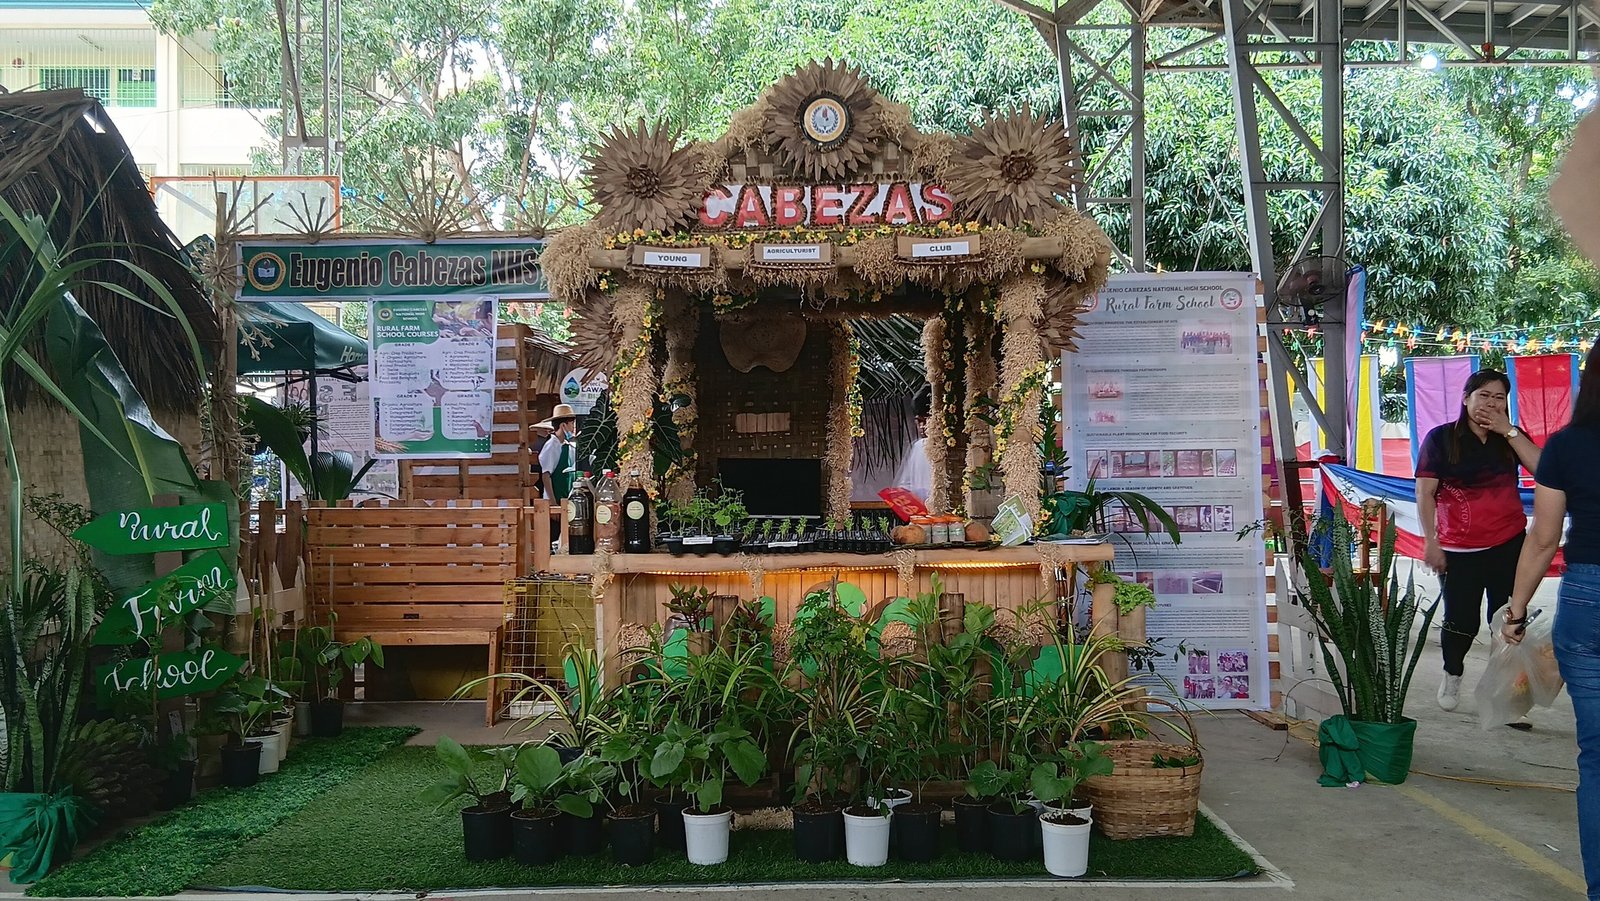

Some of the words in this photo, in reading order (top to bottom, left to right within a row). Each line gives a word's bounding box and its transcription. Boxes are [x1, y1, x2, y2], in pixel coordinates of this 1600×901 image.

[698, 182, 953, 228] CABEZAS
[289, 252, 383, 292] Eugenio
[388, 250, 487, 289] Cabezas
[490, 249, 537, 285] NHS
[1105, 296, 1139, 314] Rural
[1144, 295, 1173, 310] Farm
[1176, 294, 1215, 311] School
[119, 507, 223, 541] Rural
